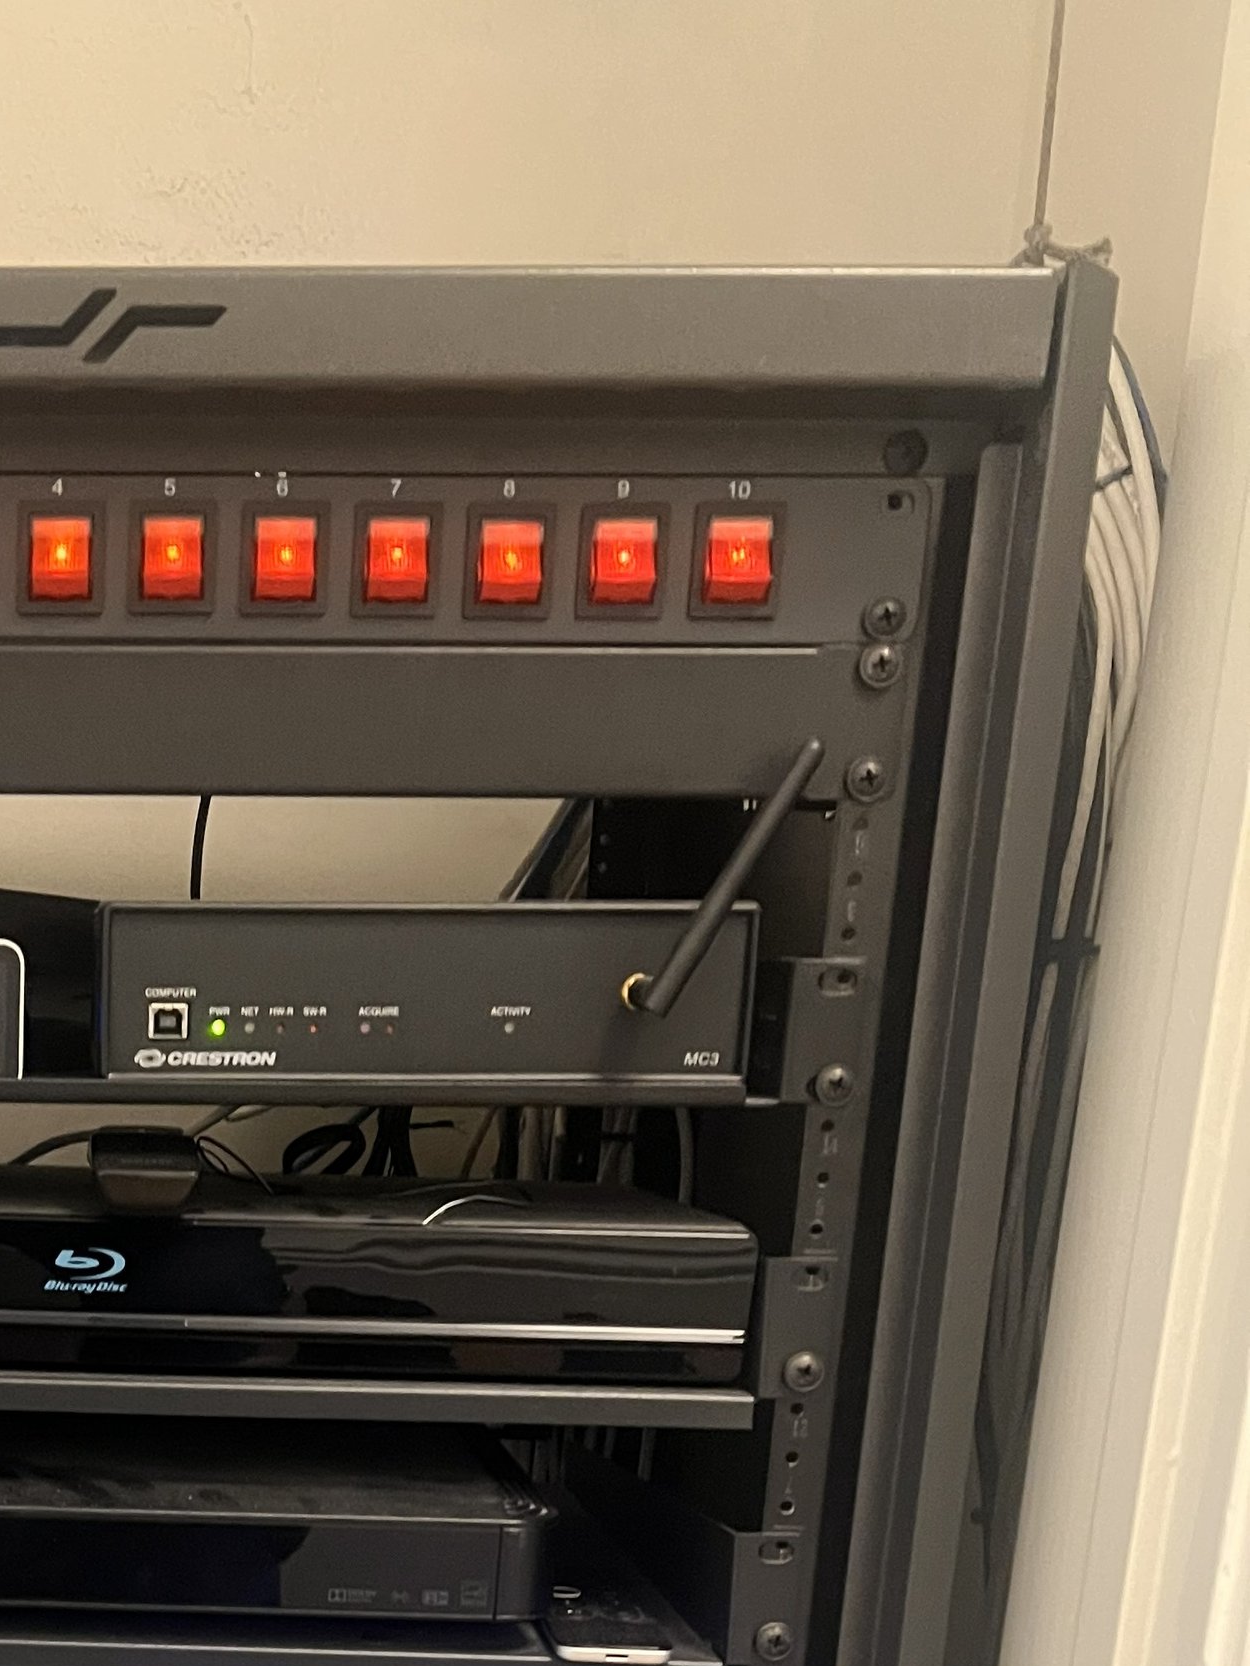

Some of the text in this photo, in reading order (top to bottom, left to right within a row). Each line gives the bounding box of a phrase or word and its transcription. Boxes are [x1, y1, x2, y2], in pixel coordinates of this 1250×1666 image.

[51, 478, 63, 496] 4
[164, 478, 176, 496] 5
[390, 479, 402, 497] 7
[503, 479, 515, 498] 8
[617, 479, 630, 498] 9
[729, 480, 751, 499] 10
[145, 987, 196, 998] COMPUTER
[491, 1006, 531, 1017] ACTIVITY
[167, 1051, 276, 1067] CRESTRON
[683, 1051, 720, 1067] MC3
